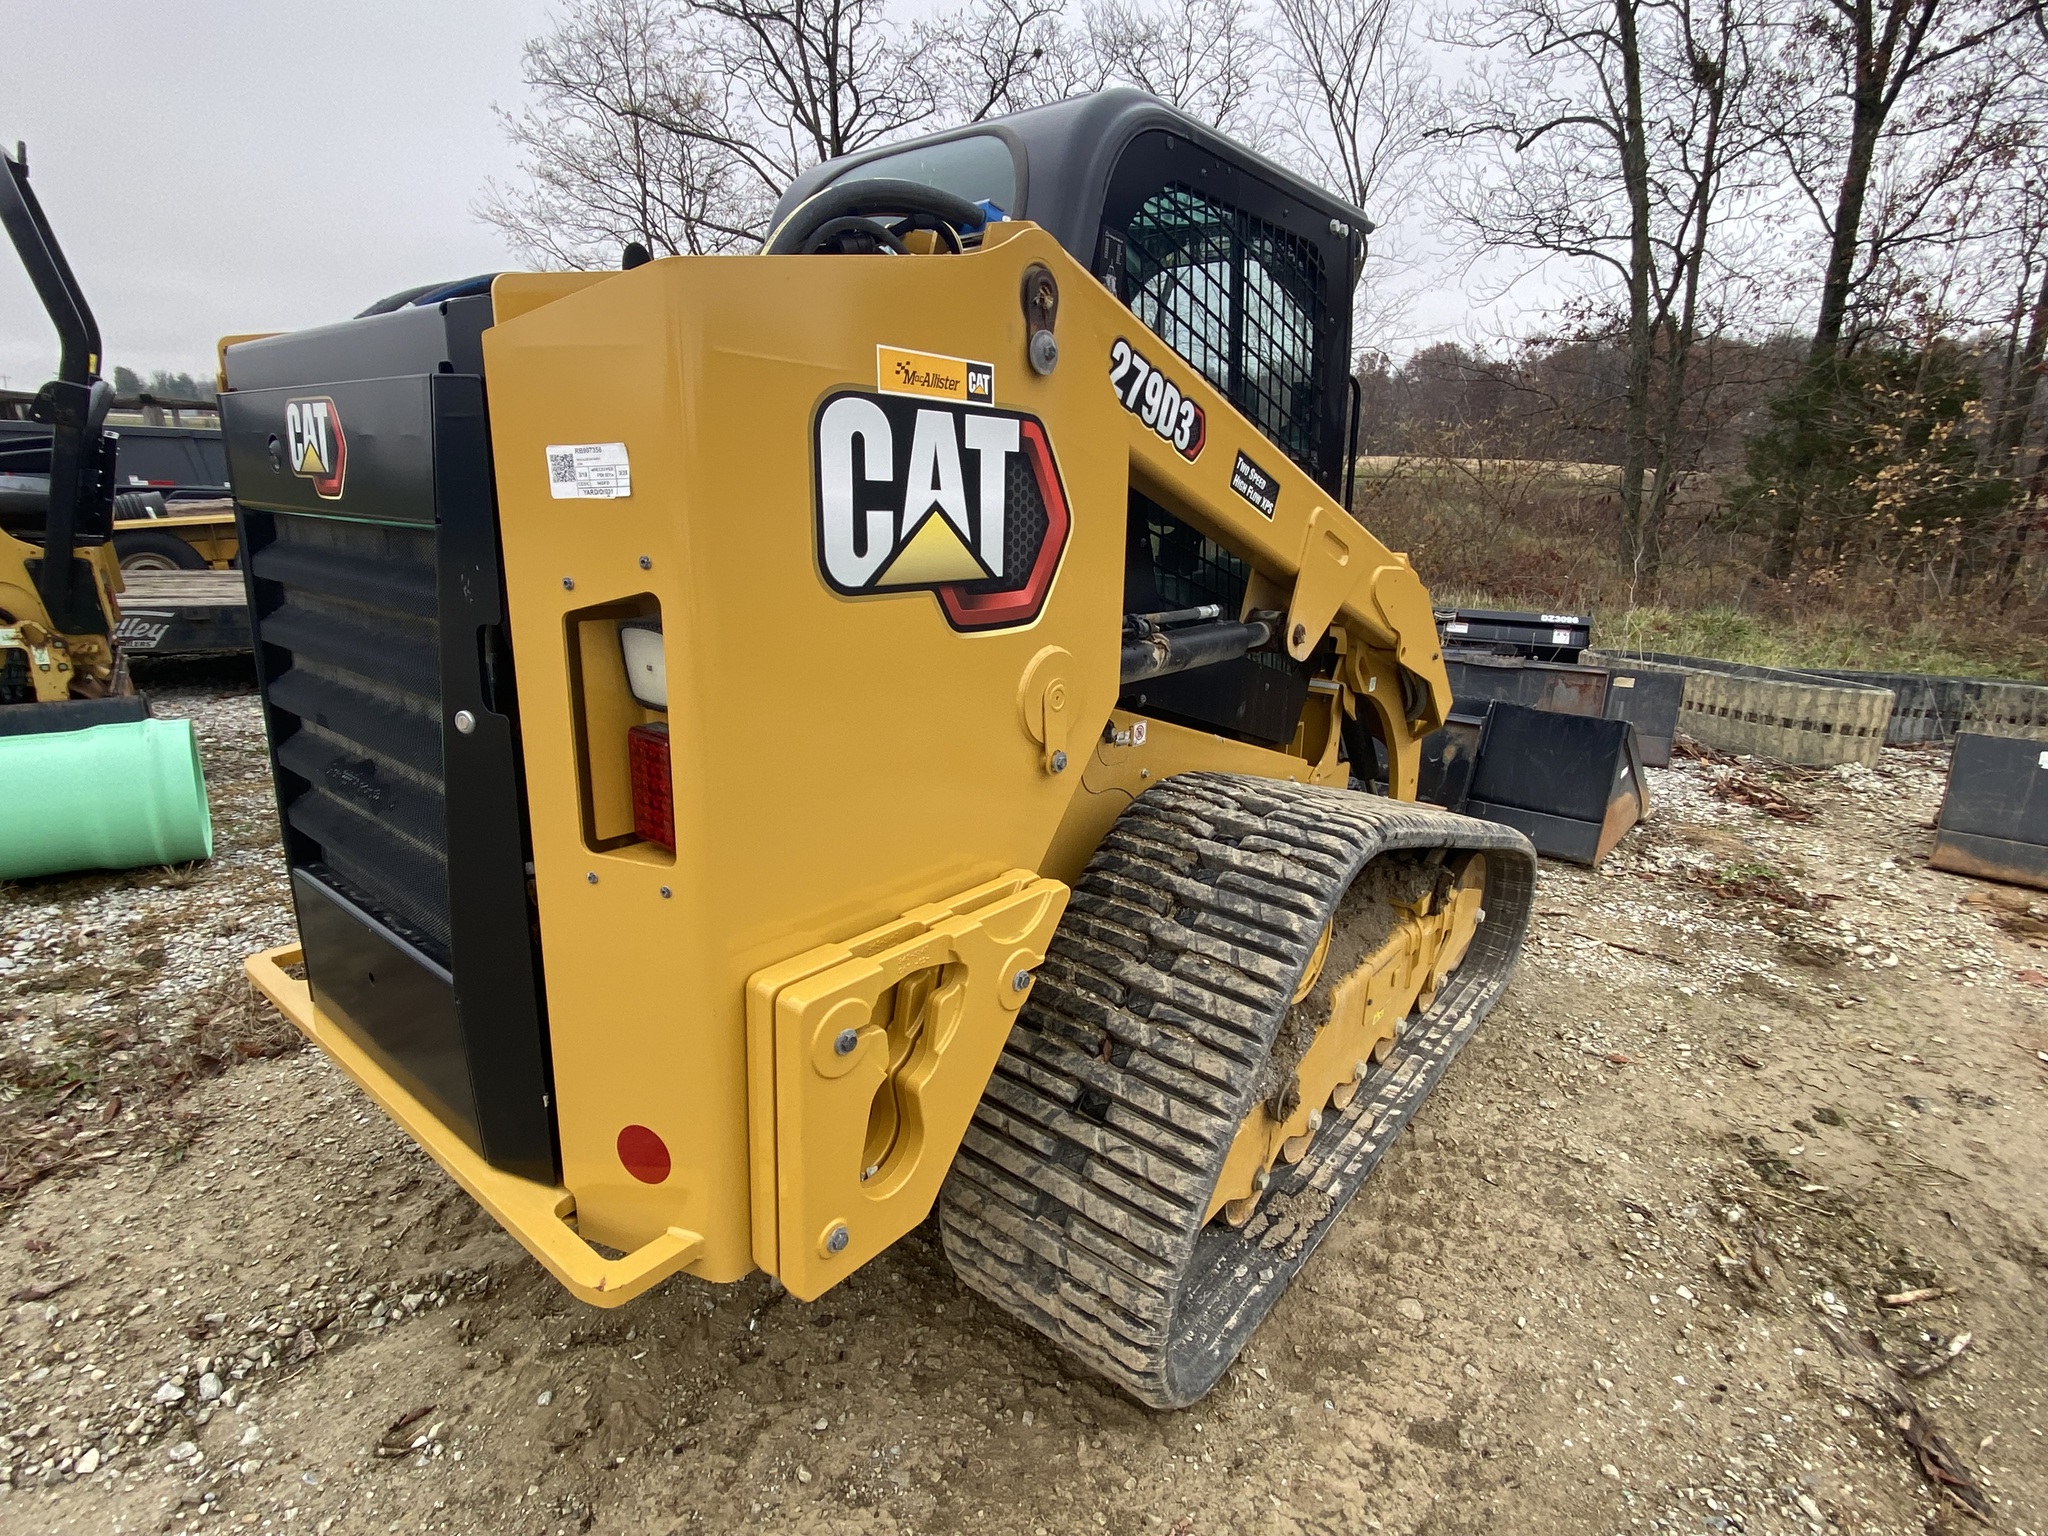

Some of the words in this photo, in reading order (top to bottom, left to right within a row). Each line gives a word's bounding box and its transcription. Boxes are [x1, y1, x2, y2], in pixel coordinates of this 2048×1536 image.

[902, 369, 960, 391] MacAllister
[968, 371, 991, 395] CAT
[1109, 341, 1195, 450] 279D3
[287, 403, 329, 472] CAT
[820, 397, 1020, 587] CAT
[1260, 497, 1274, 514] XPS
